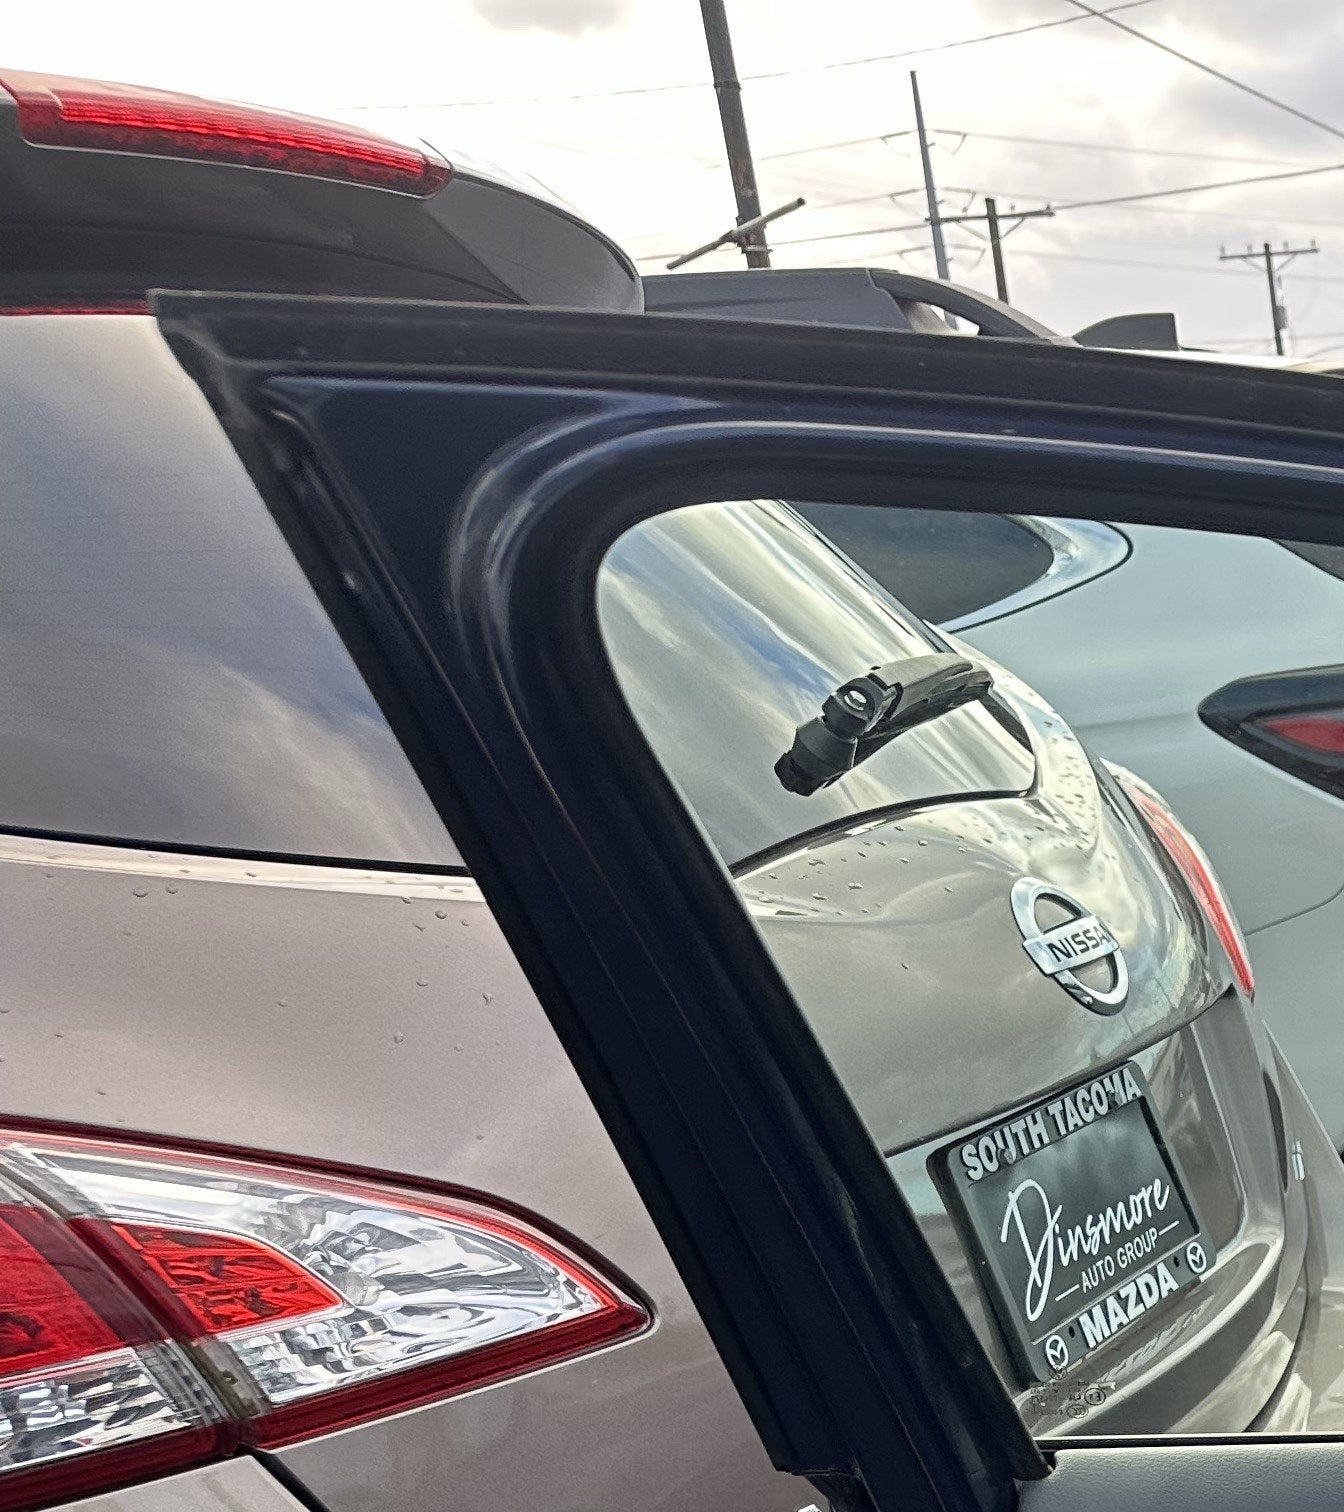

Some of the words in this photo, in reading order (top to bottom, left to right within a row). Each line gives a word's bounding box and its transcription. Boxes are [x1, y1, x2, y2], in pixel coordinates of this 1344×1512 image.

[961, 1112, 1050, 1182] SOUTH
[1048, 1067, 1143, 1137] TACOMA
[1001, 1178, 1170, 1322] Dinsmore
[1081, 1258, 1115, 1294] AUTO
[1116, 1226, 1160, 1270] GROUP
[1078, 1261, 1180, 1349] MAZDA
